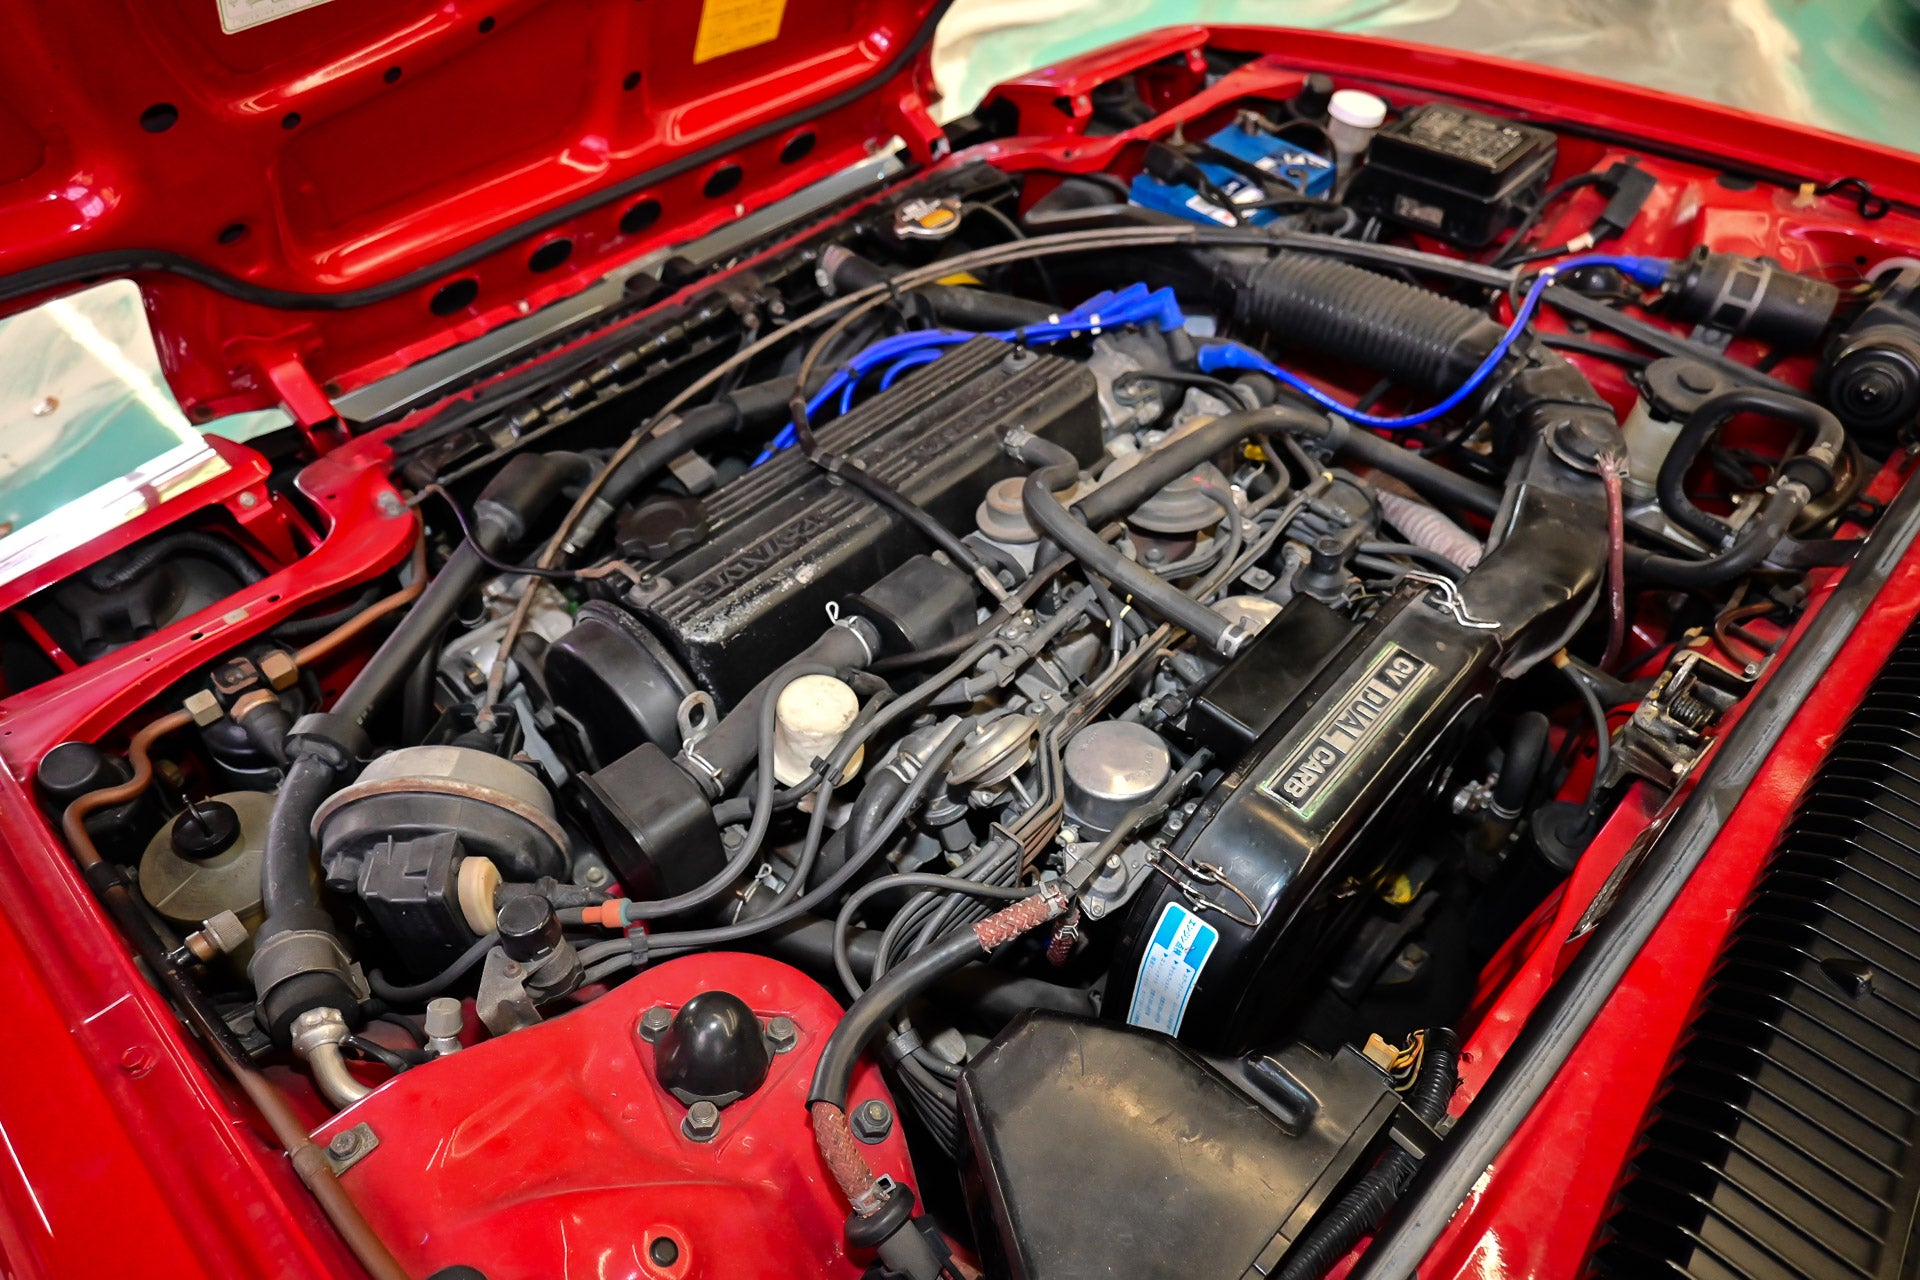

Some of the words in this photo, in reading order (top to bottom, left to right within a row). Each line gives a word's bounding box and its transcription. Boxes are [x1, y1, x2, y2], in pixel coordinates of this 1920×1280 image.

[1385, 656, 1416, 686] CV
[1325, 686, 1392, 740] DUAL
[1283, 745, 1336, 798] CARB
